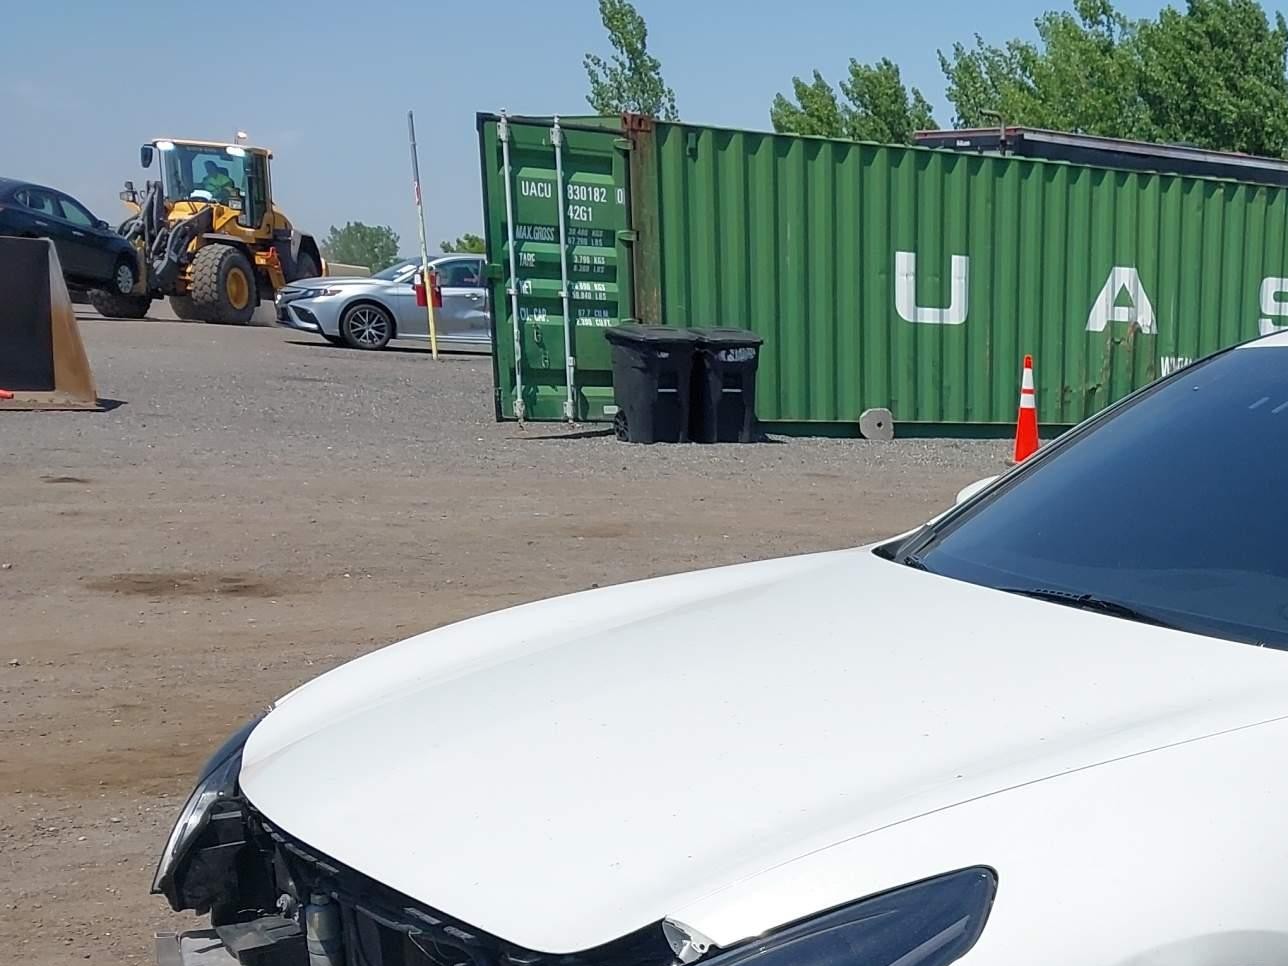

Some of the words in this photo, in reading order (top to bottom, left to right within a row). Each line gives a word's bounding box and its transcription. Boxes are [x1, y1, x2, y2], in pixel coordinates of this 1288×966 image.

[521, 181, 552, 198] UACU
[567, 184, 608, 203] 830182
[617, 188, 624, 204] 0
[567, 205, 593, 222] 42G1
[519, 253, 536, 267] TARE
